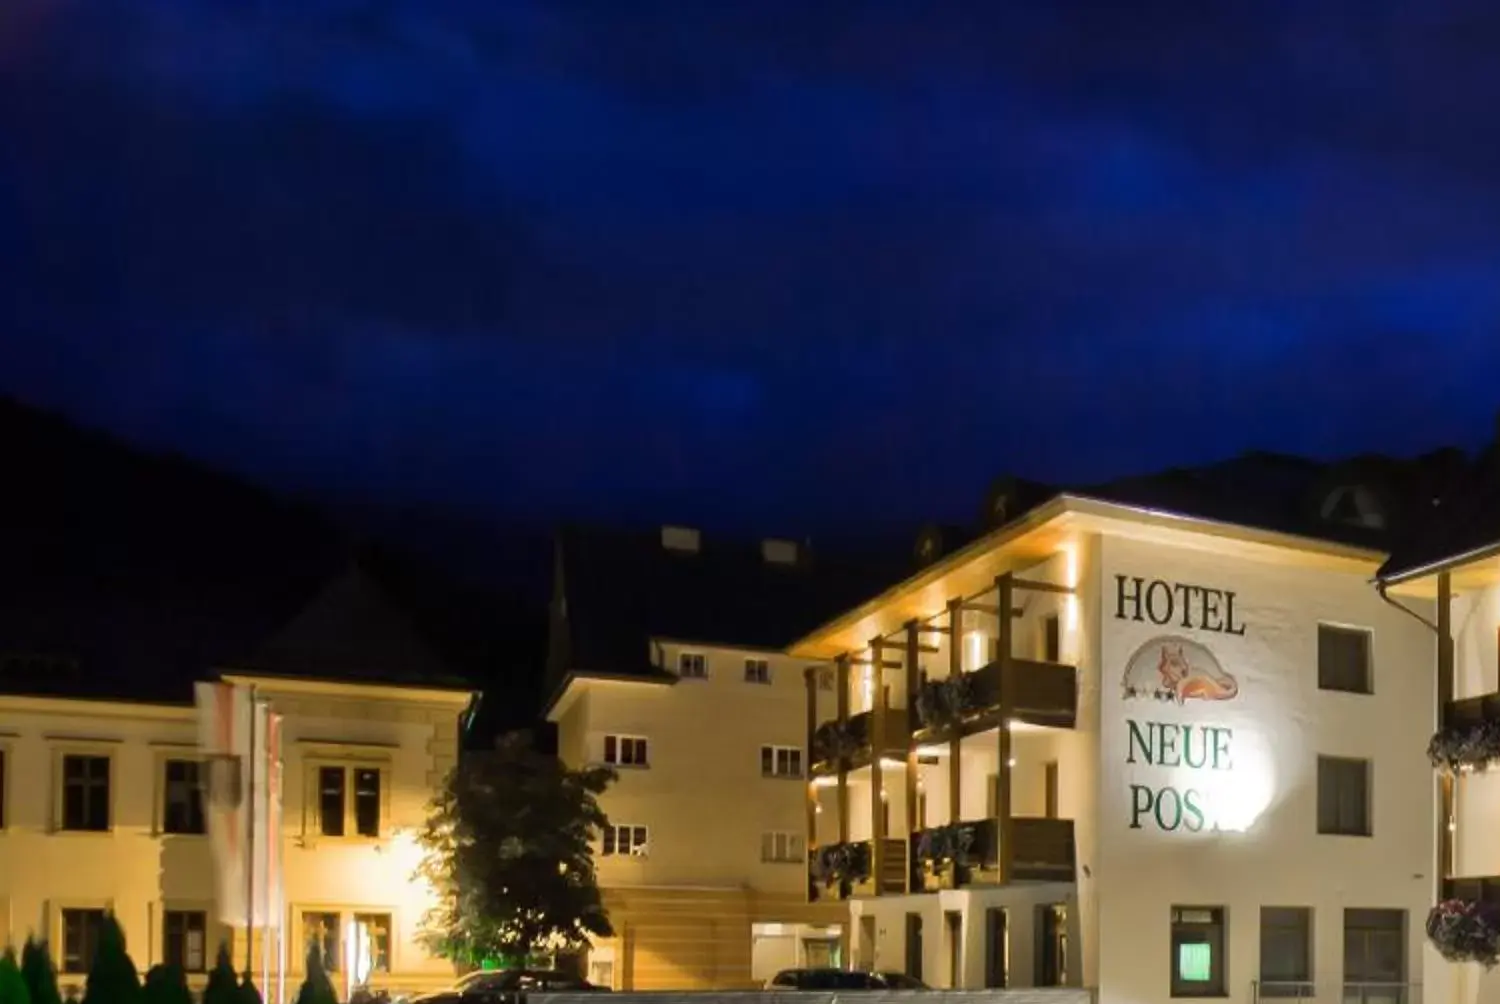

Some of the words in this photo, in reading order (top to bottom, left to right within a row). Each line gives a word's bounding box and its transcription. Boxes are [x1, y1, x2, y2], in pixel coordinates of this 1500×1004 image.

[1114, 574, 1246, 636] HOTEL
[1125, 719, 1233, 770] NEUE
[1129, 784, 1226, 833] POS
